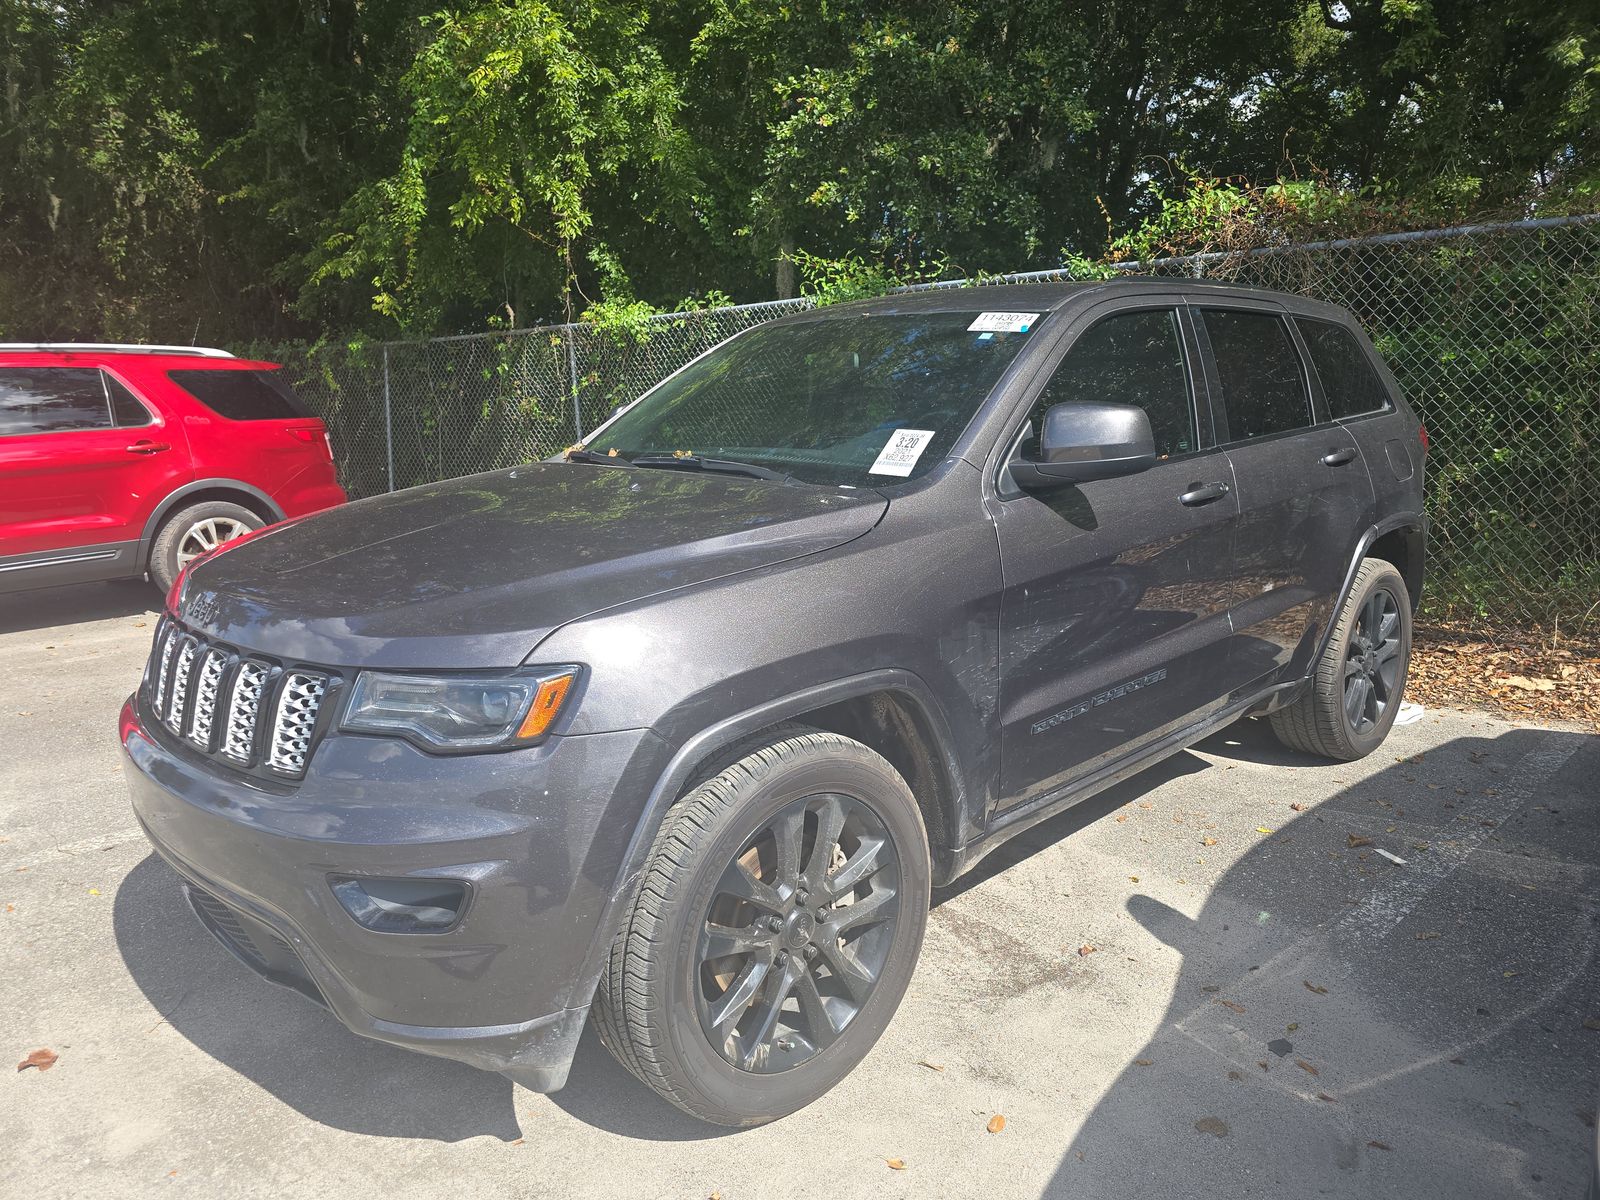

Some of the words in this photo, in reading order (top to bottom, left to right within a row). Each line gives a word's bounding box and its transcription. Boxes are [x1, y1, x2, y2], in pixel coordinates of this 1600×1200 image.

[982, 314, 1034, 322] 1143074
[895, 437, 919, 449] 3:20
[1031, 700, 1089, 736] GRAND
[1091, 668, 1168, 707] CHEROKEE
